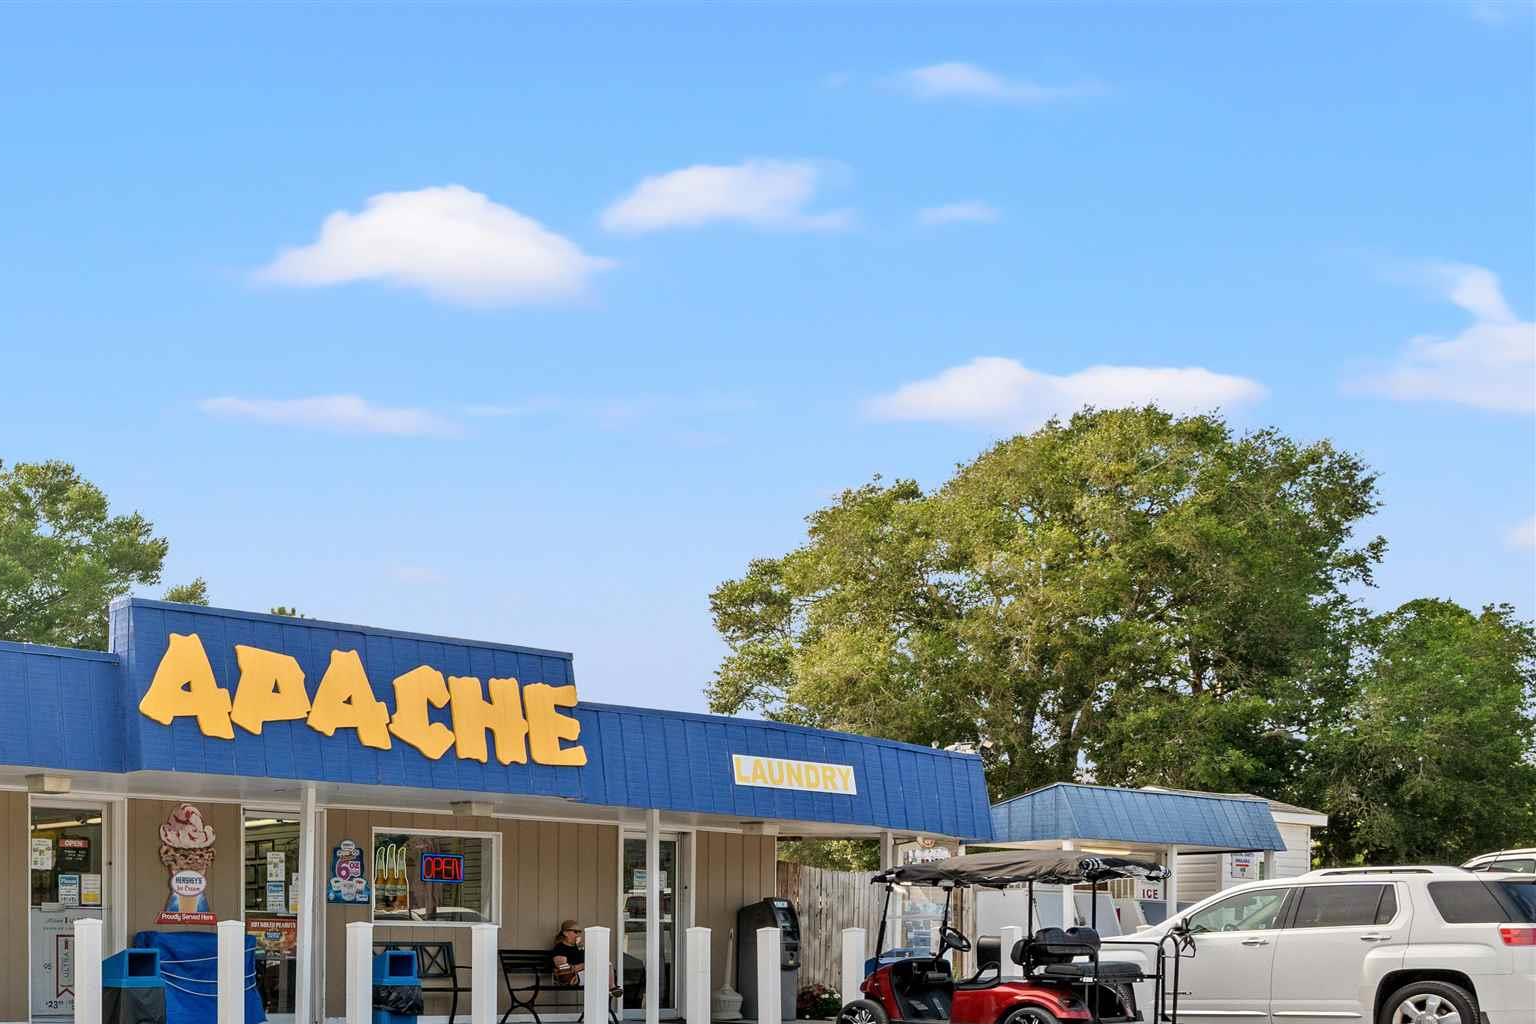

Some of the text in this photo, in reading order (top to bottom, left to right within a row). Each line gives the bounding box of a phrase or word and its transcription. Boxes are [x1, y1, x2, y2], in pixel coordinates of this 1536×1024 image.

[139, 633, 588, 766] APACHE
[733, 757, 851, 791] LAUNDRY
[424, 857, 462, 880] OPEN
[1142, 888, 1159, 899] ICE
